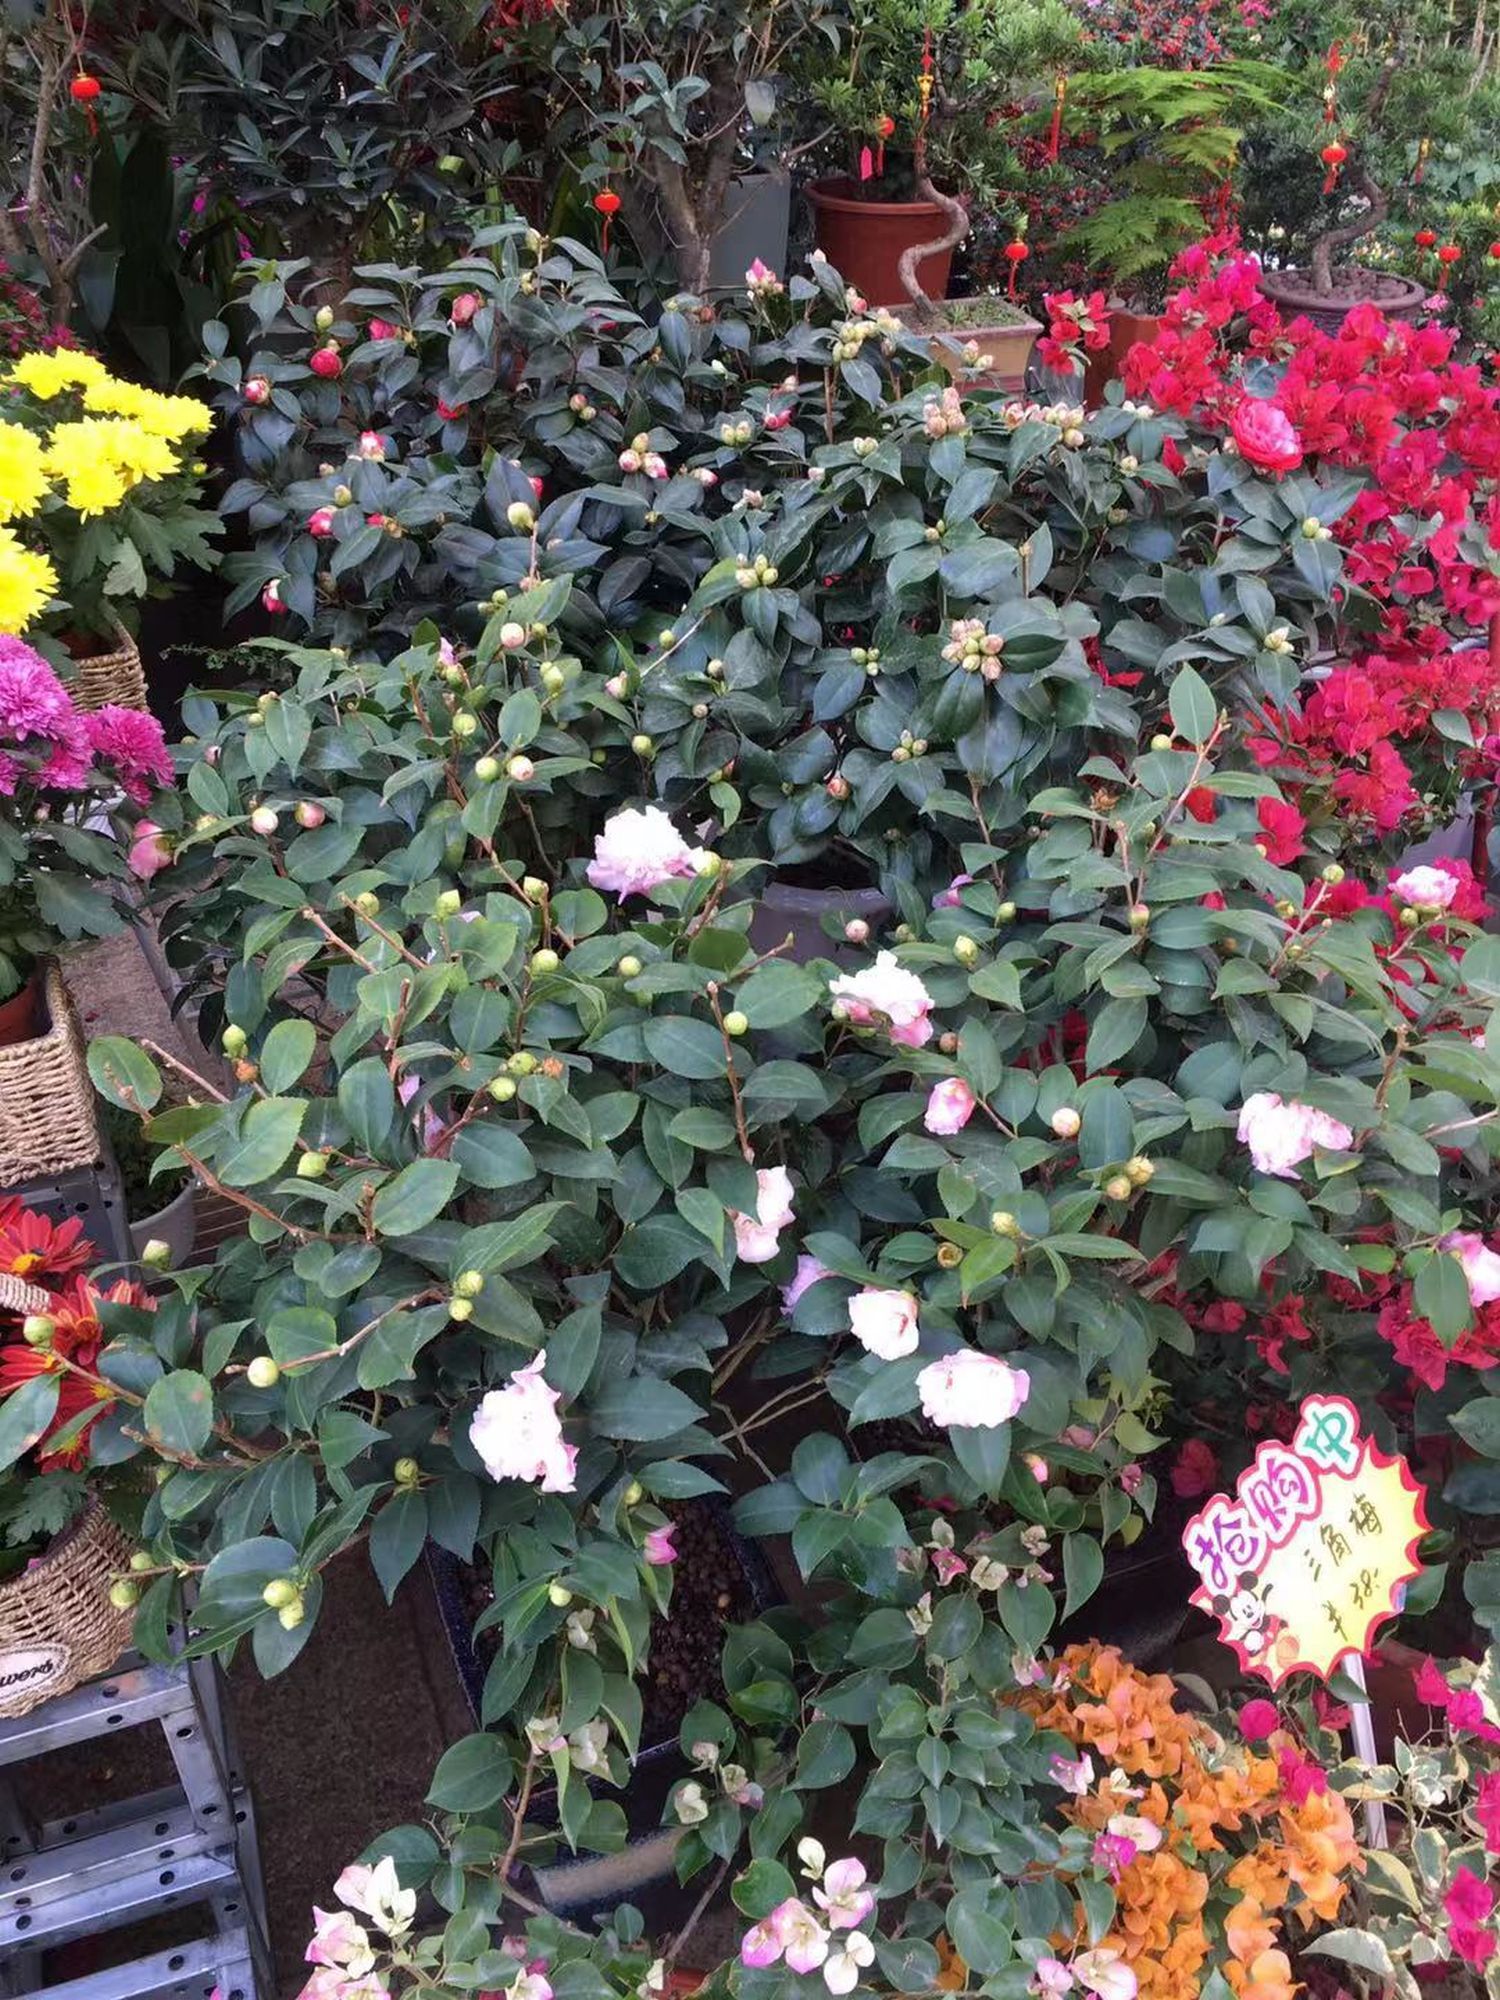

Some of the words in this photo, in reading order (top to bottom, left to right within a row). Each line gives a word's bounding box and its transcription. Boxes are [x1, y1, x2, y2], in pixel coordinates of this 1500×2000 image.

[1195, 1411, 1348, 1590] 抢购中
[1303, 1493, 1383, 1583] 三角梅
